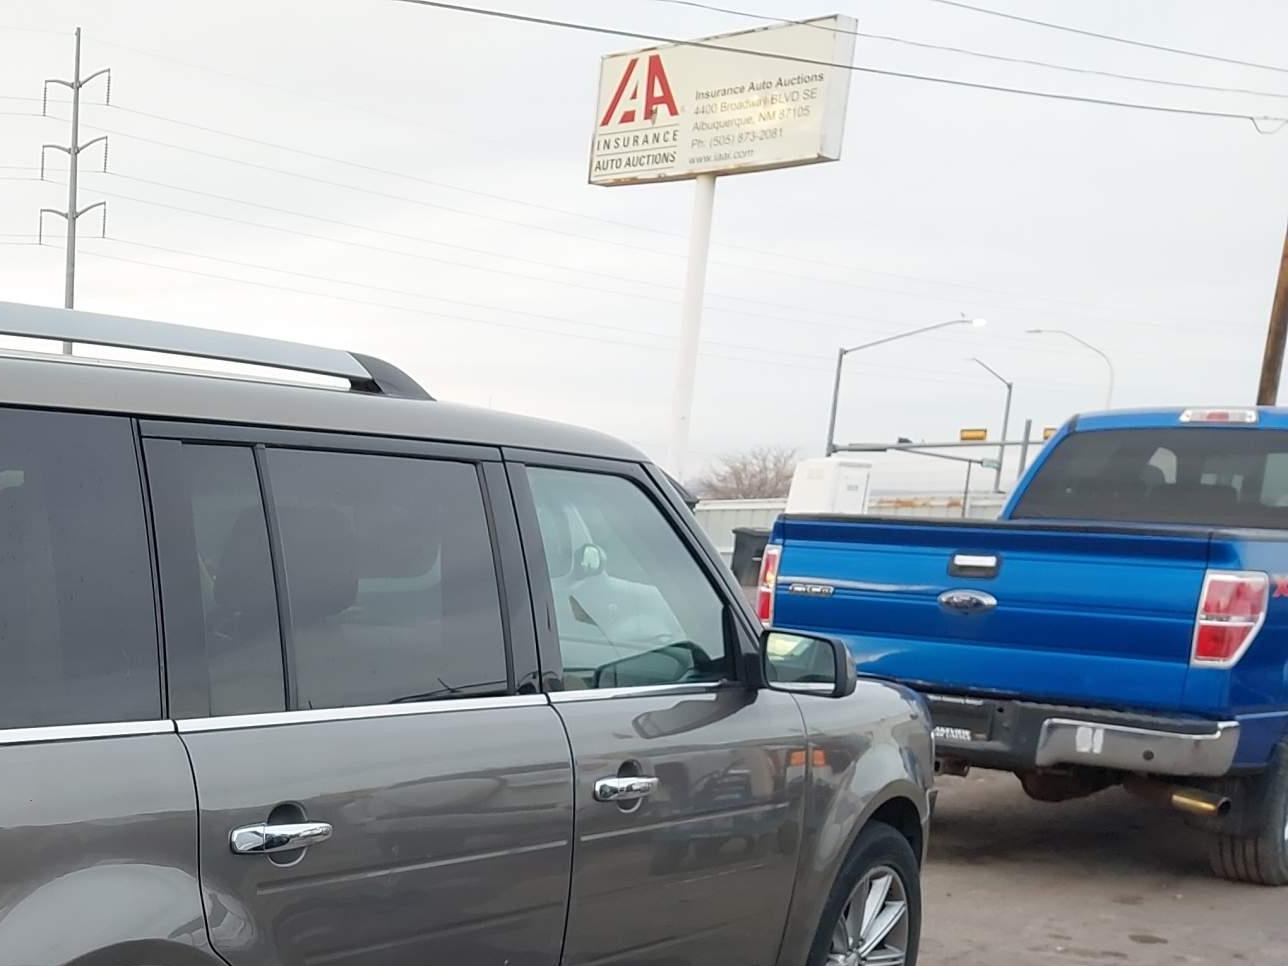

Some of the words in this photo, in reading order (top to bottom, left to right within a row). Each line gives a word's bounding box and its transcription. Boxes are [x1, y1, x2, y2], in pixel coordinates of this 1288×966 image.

[695, 85, 745, 100] Insurance
[748, 80, 773, 92] Auto
[775, 72, 824, 88] Auctions
[771, 91, 799, 104] BLVD
[802, 88, 818, 100] SE
[758, 111, 776, 122] NM
[596, 129, 679, 151] INSURANCE
[595, 158, 622, 172] AUTO
[624, 151, 676, 168] AUCTIONS
